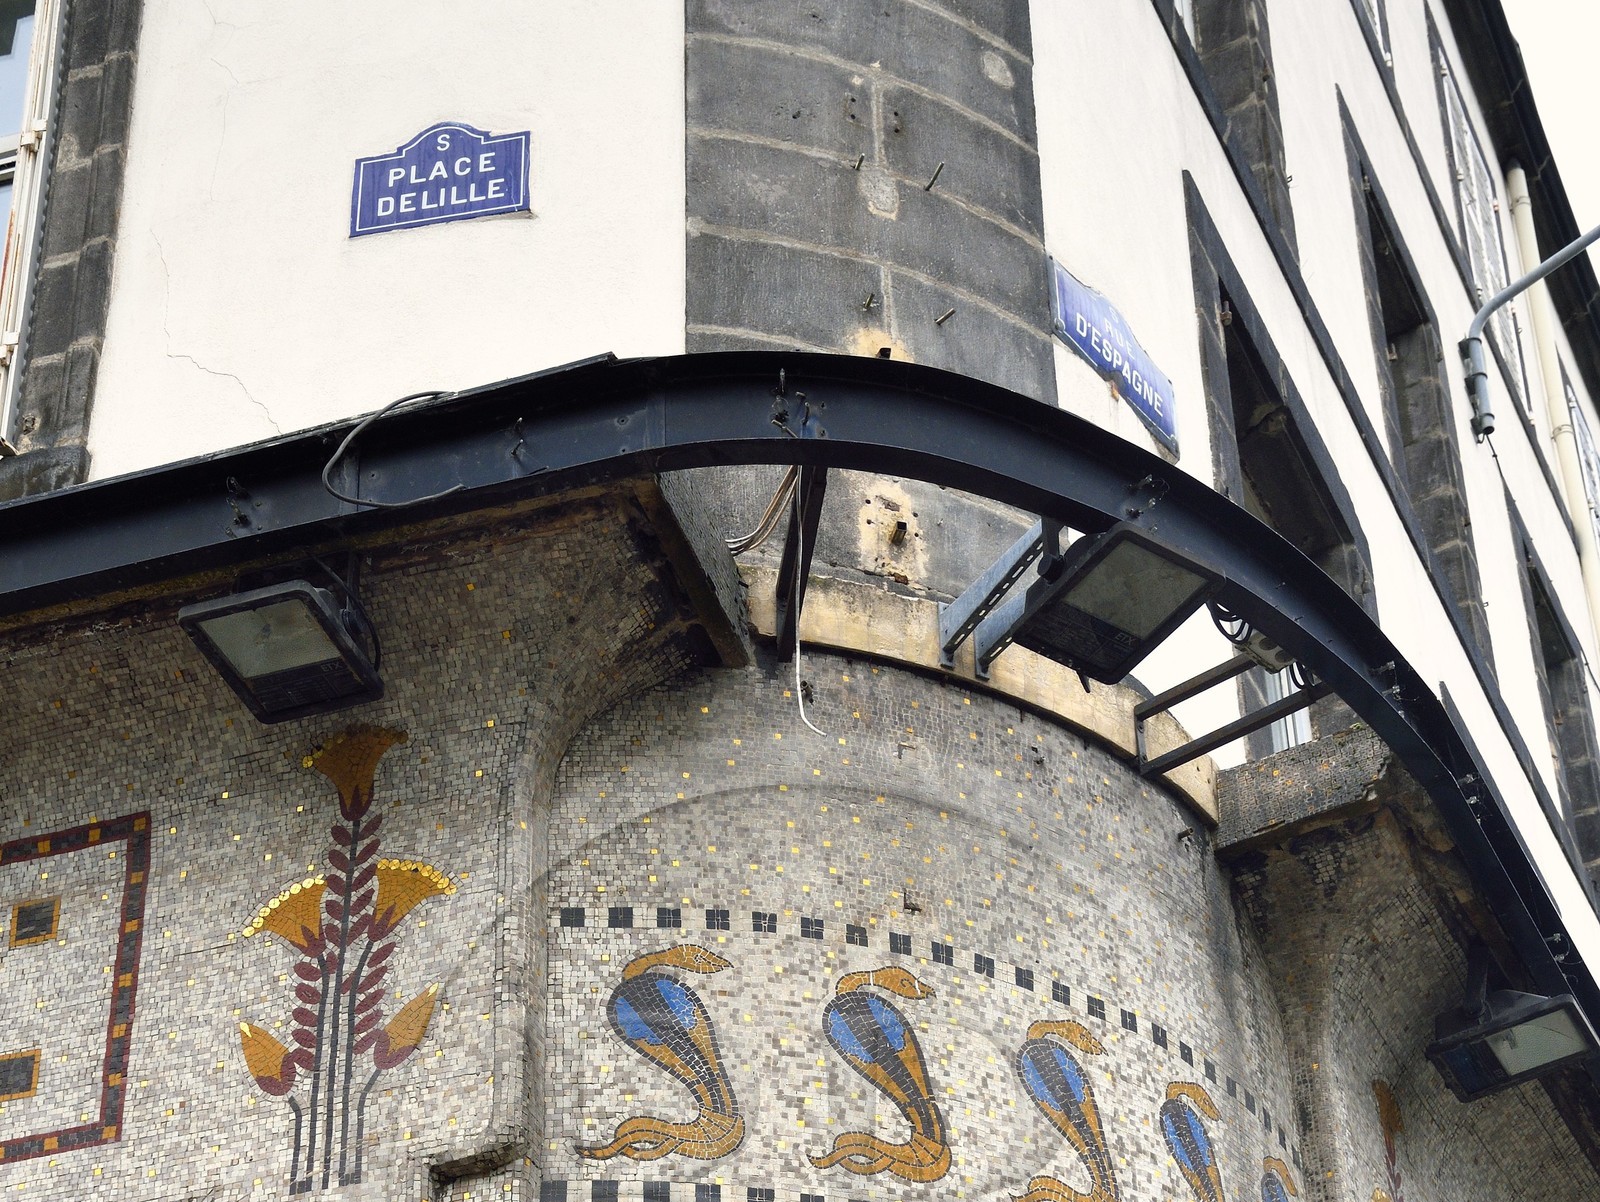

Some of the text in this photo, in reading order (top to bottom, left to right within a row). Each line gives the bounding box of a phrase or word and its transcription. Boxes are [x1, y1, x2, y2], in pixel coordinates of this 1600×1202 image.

[437, 134, 450, 151] S
[388, 152, 496, 188] PLACE
[377, 178, 505, 217] DELILLE
[1104, 318, 1135, 360] RUE
[1076, 312, 1164, 417] D'ESPAGNE
